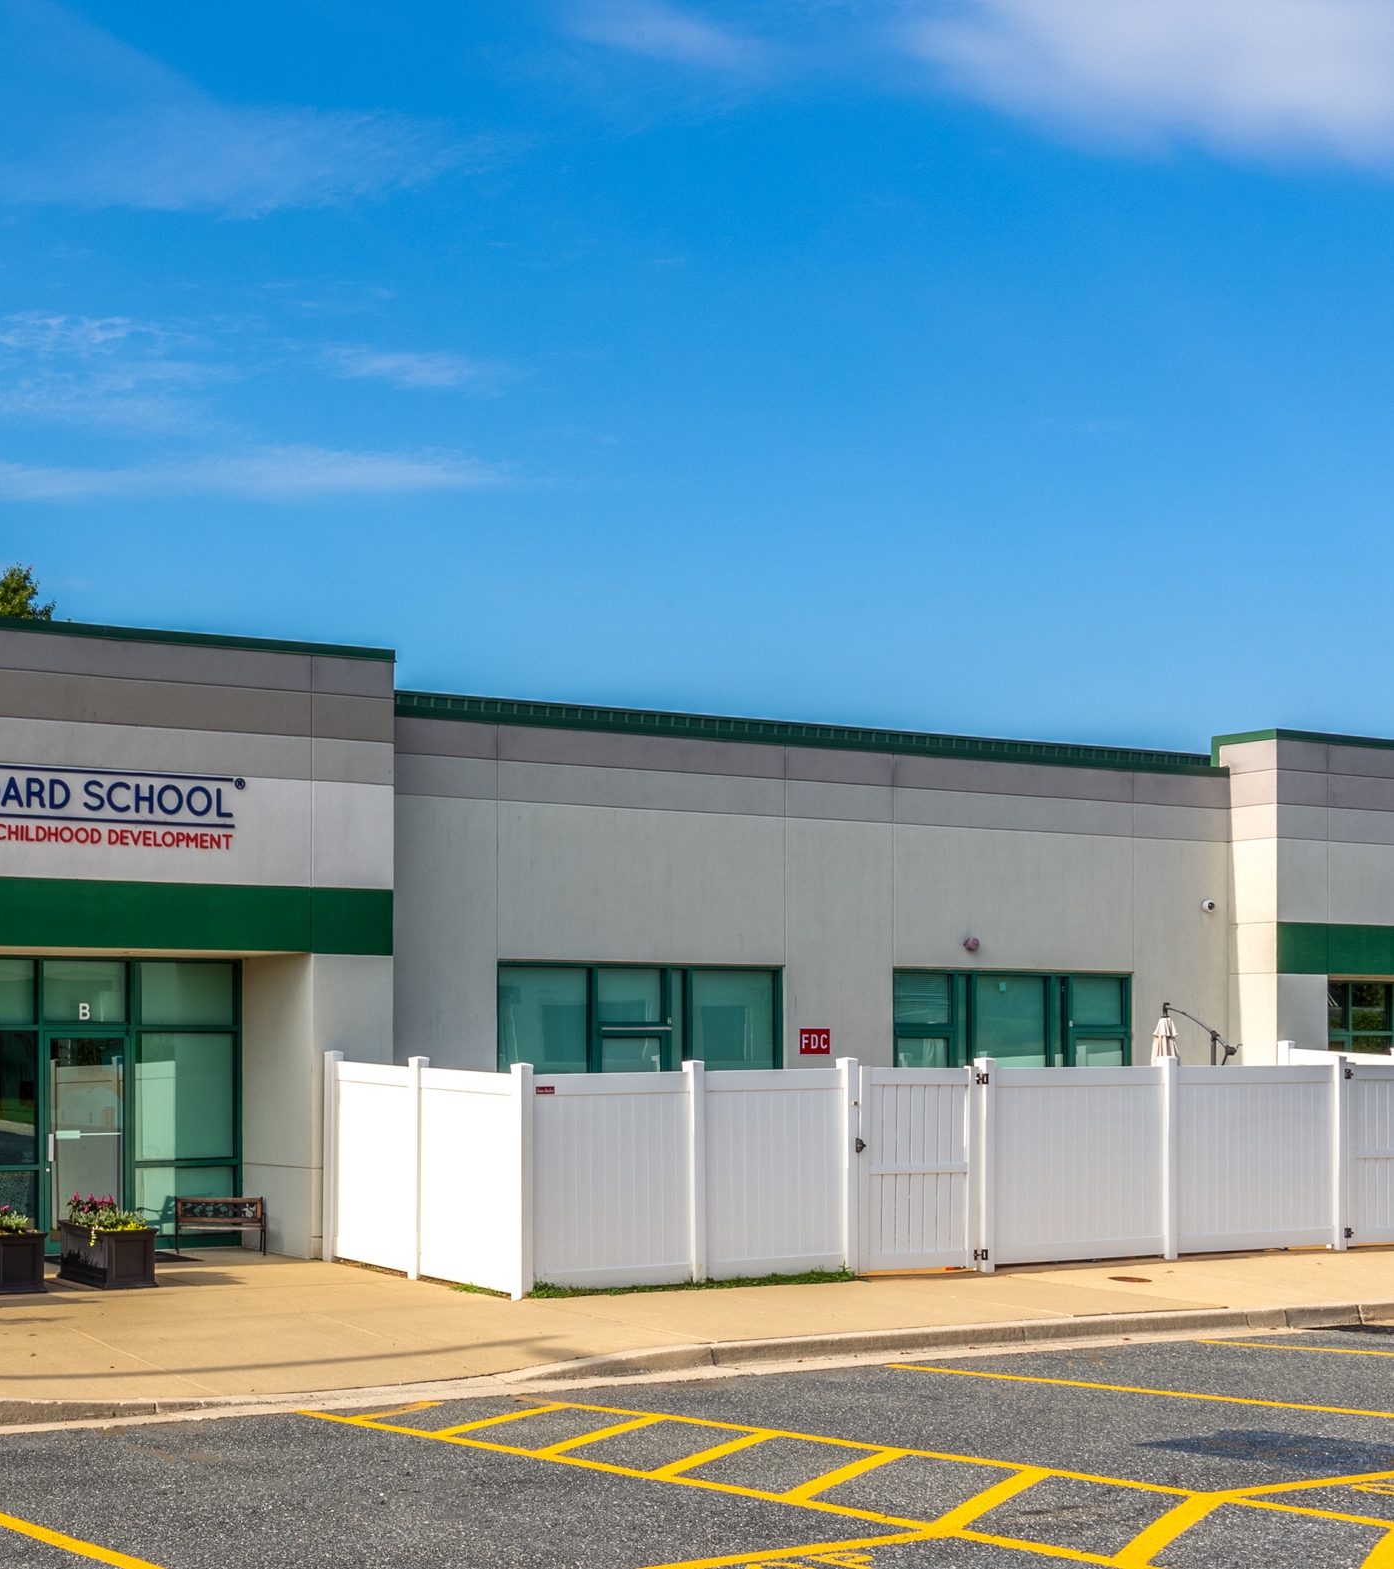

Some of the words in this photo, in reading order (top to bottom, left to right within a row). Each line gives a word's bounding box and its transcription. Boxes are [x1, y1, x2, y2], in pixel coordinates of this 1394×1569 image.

[83, 780, 233, 818] SCHOOL
[107, 828, 234, 851] DEVELOPMENT
[79, 1002, 91, 1020] B
[801, 1033, 828, 1050] FDC
